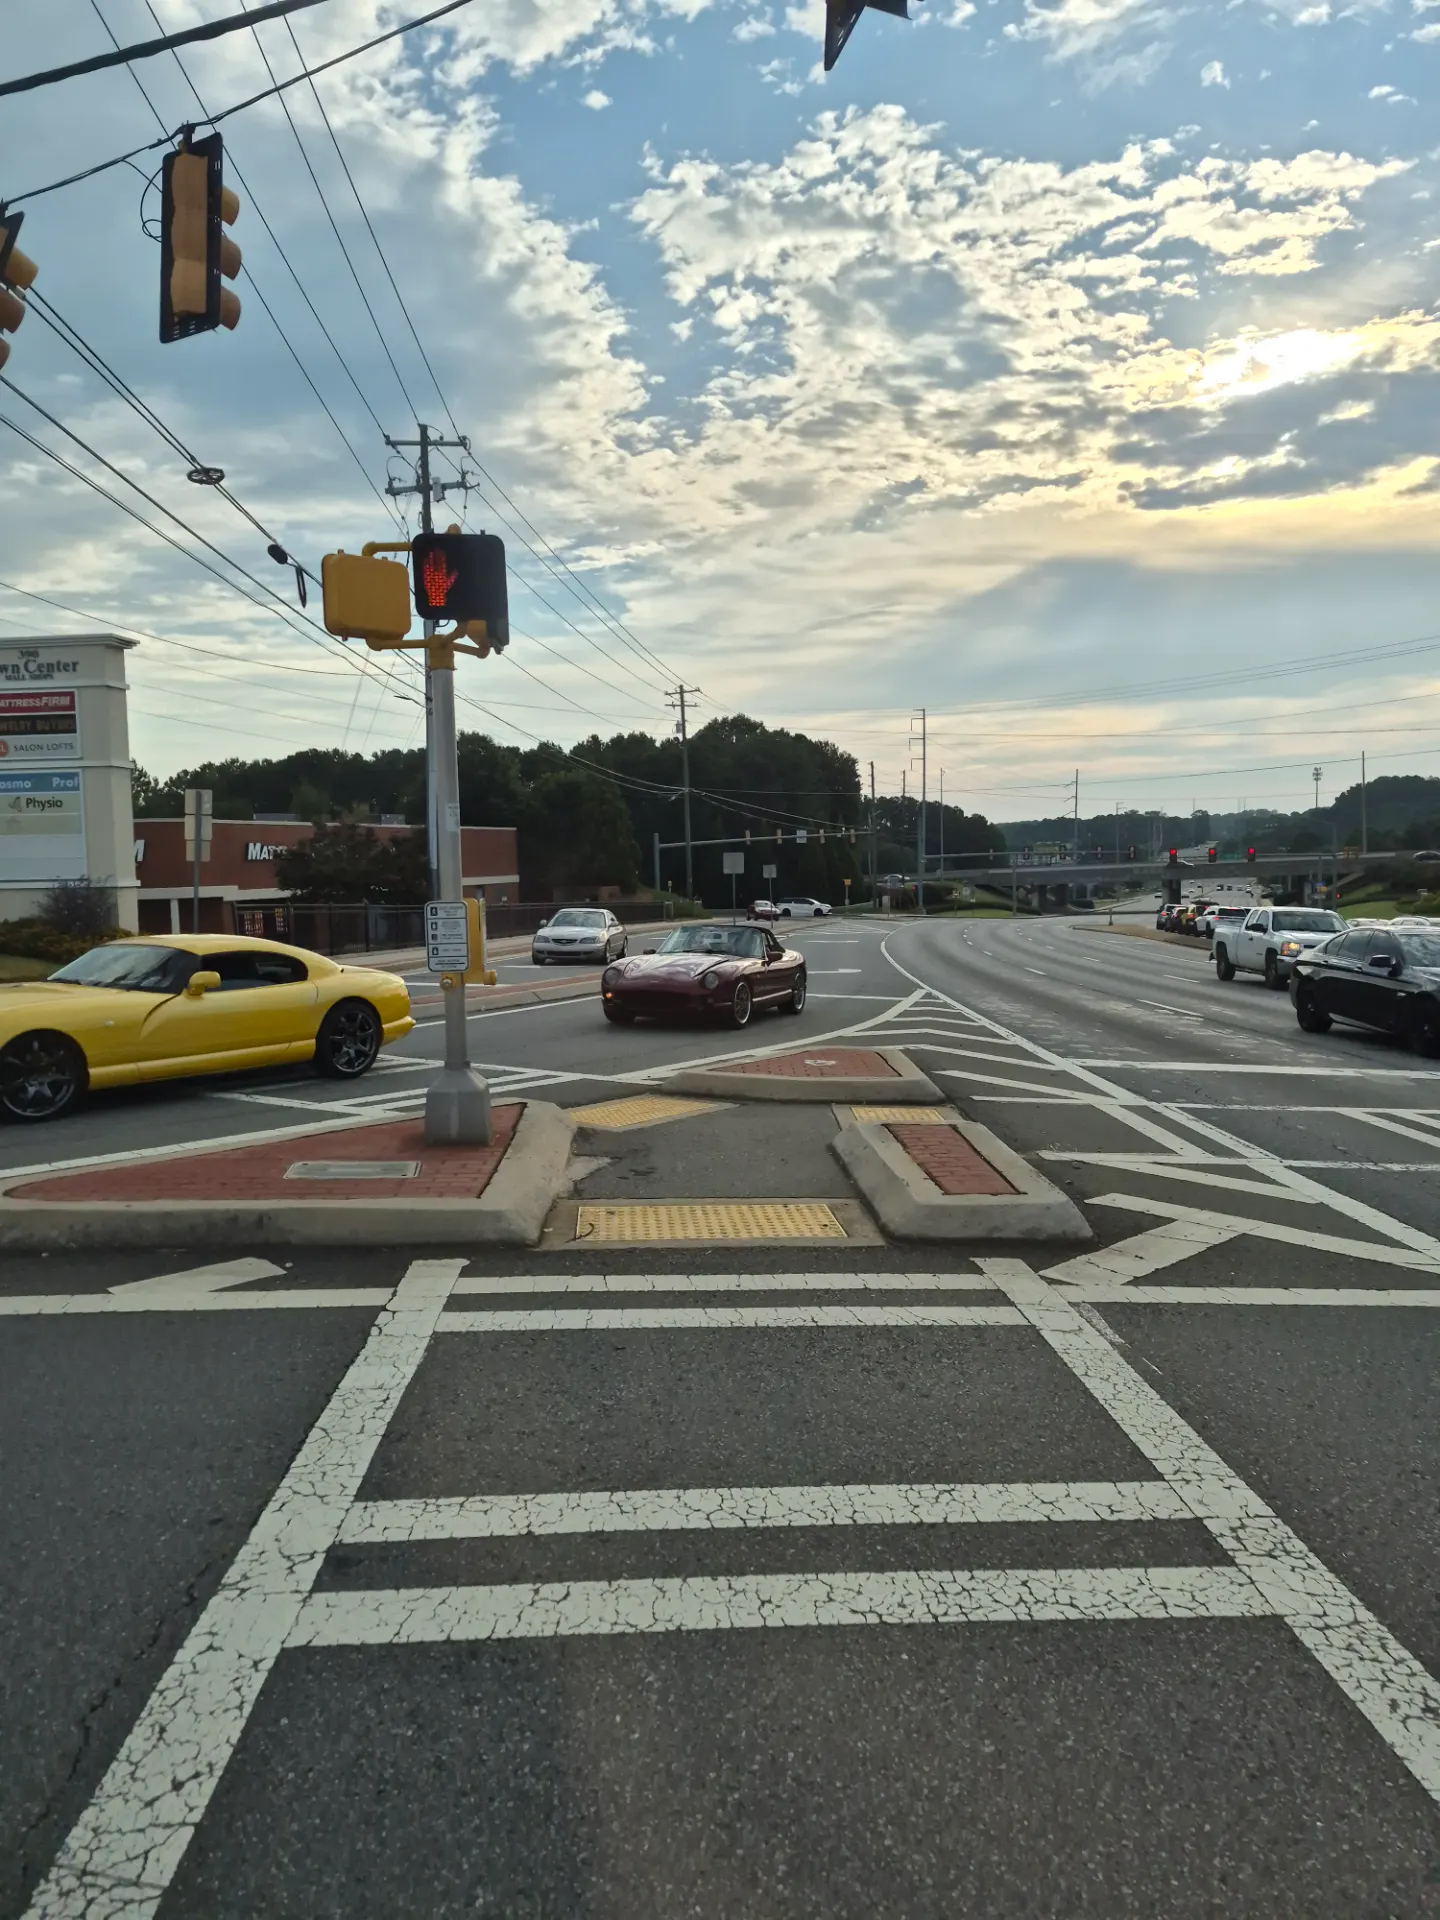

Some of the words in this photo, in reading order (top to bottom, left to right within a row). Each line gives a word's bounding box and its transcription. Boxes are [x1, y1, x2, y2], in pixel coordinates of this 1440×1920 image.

[24, 659, 79, 673] Center
[13, 743, 43, 752] SALON
[46, 742, 75, 751] LOFTS
[52, 775, 80, 788] Prof
[25, 796, 63, 812] Physio
